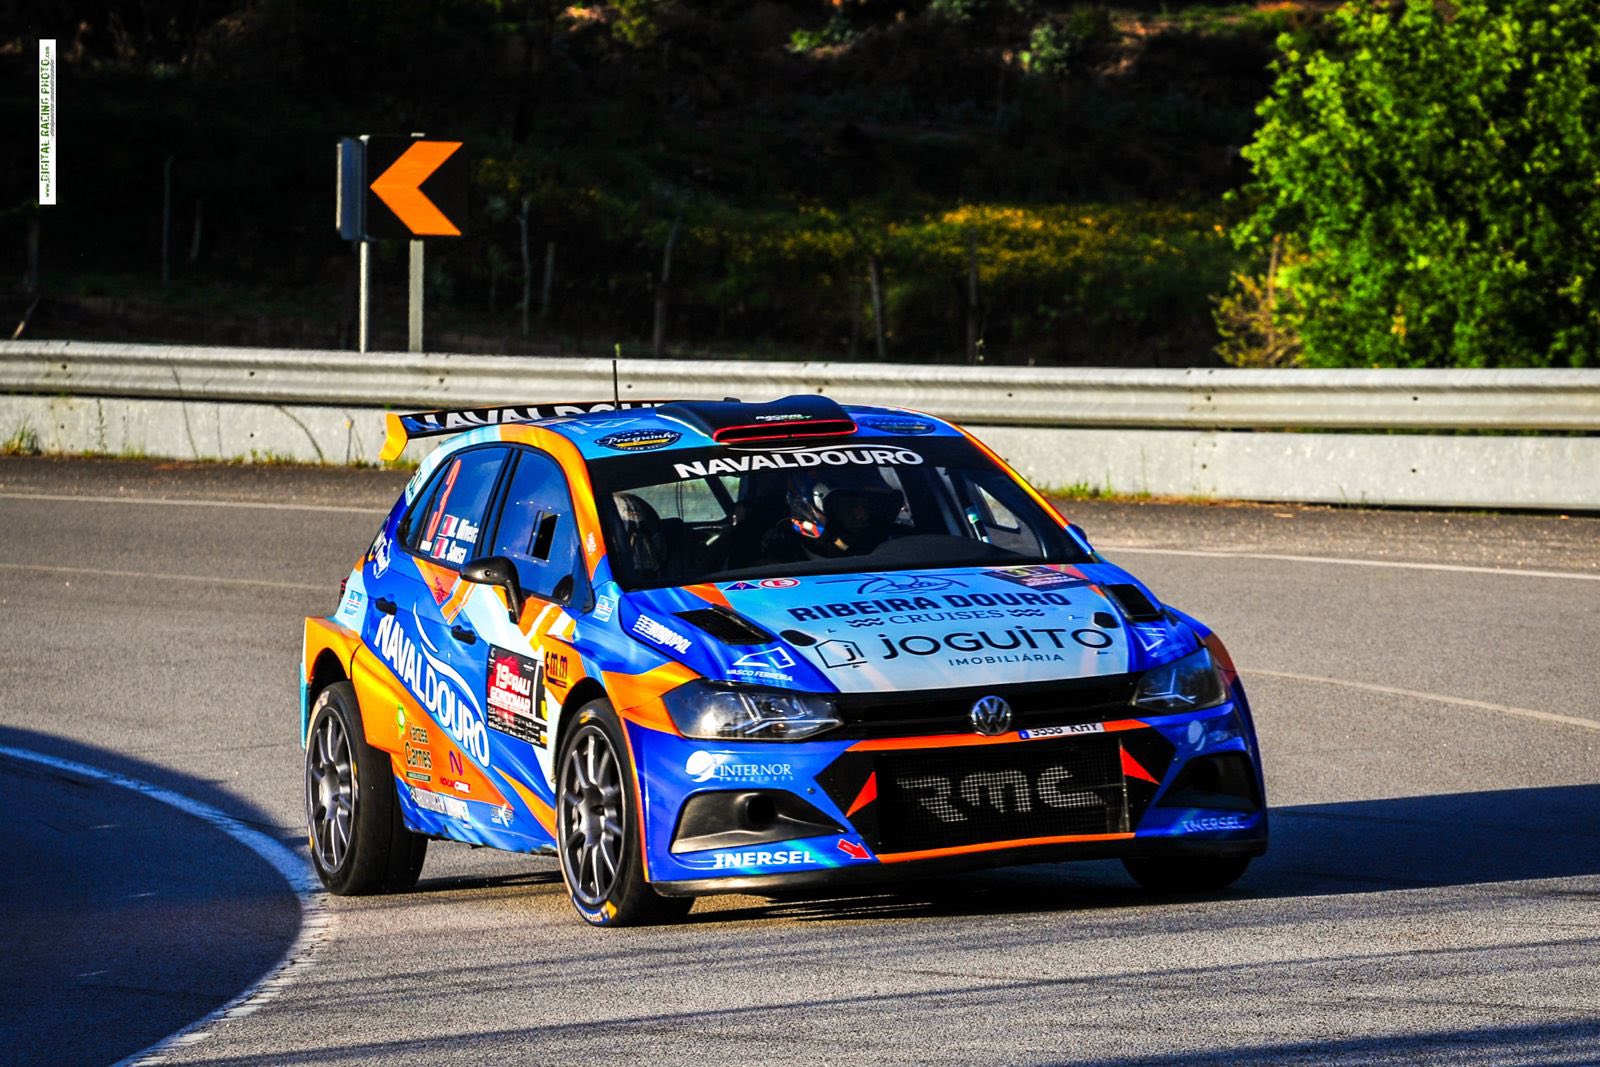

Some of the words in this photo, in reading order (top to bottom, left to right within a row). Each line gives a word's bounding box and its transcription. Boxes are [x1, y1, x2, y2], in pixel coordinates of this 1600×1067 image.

[674, 450, 924, 478] NAVALDOURO
[787, 596, 942, 621] RIBEIRA
[944, 592, 1072, 608] DOURO
[889, 609, 1004, 624] CRUISES
[949, 653, 1065, 666] IMOBILIÁRIA
[374, 614, 490, 767] NAVALDOURO
[720, 763, 792, 776] INTERNOR
[712, 851, 816, 868] INERSEL
